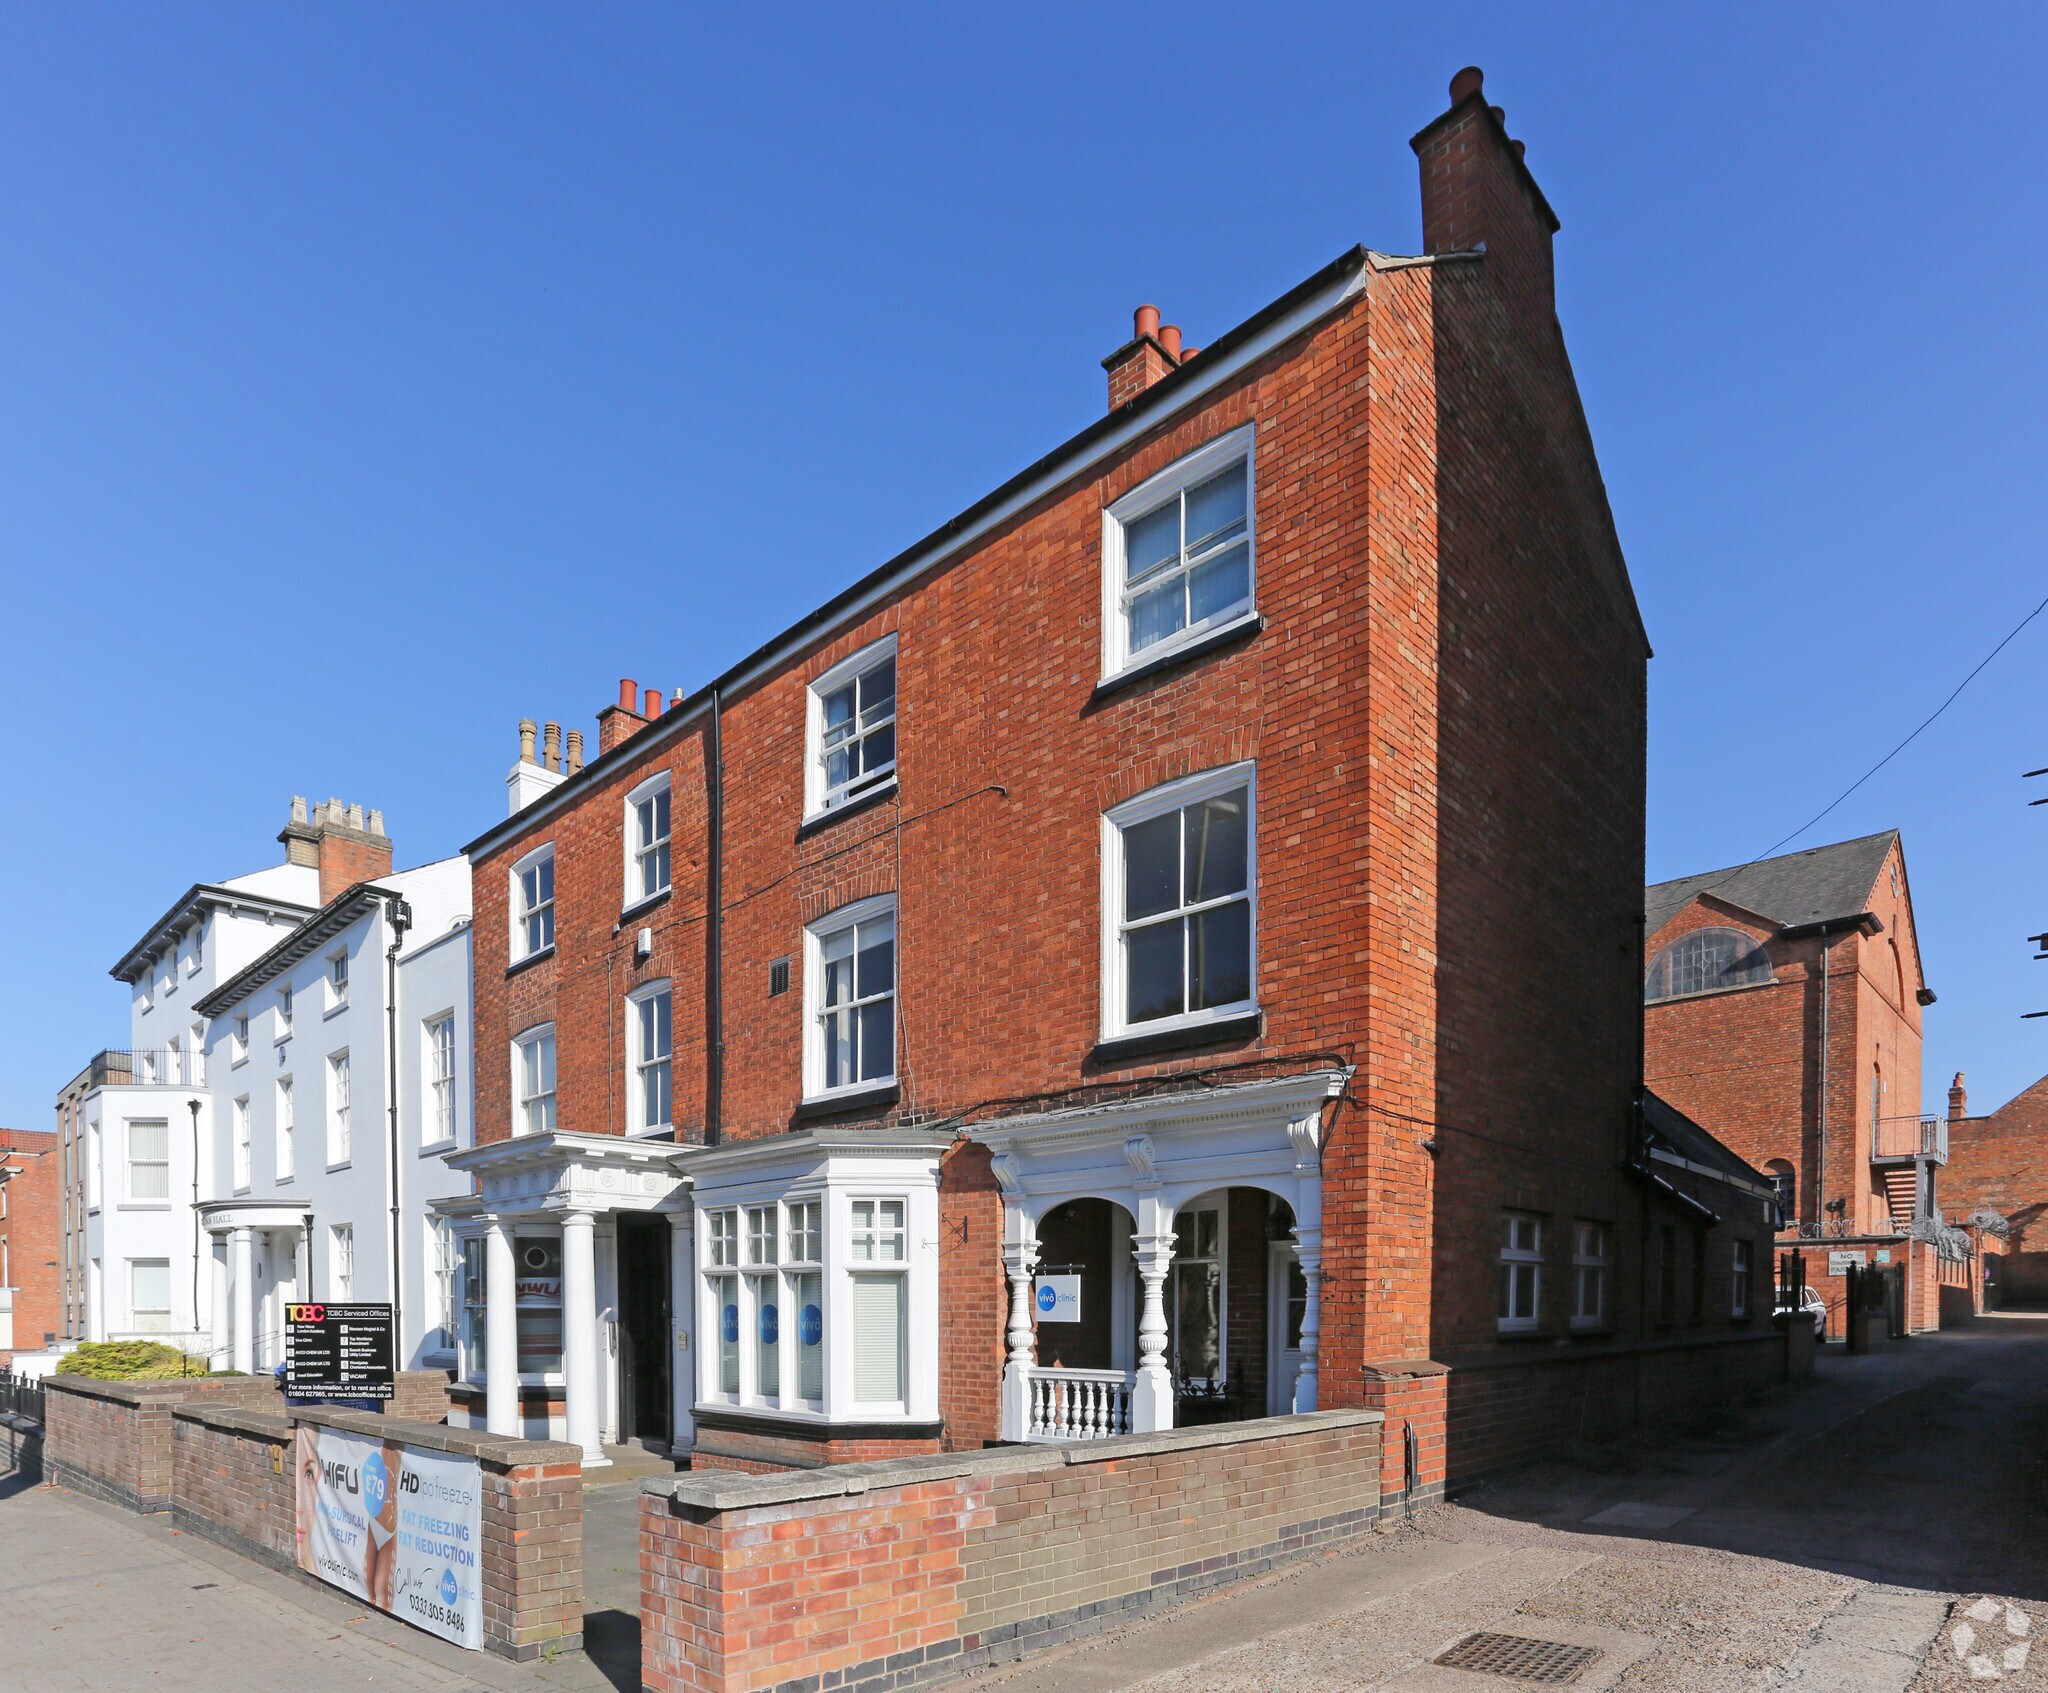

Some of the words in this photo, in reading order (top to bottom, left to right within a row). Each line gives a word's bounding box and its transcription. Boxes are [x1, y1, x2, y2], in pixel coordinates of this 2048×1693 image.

[213, 1214, 233, 1224] HALL
[1057, 1294, 1076, 1302] clinic
[321, 1459, 359, 1495] HIFU
[366, 1474, 384, 1500] £79
[400, 1470, 419, 1494] HD
[318, 1501, 366, 1531] NN-SURGICAL
[402, 1509, 416, 1526] FAT
[419, 1515, 469, 1541] FREEZING
[398, 1530, 412, 1548] FAT
[416, 1536, 474, 1567] REDUCTION
[459, 1584, 475, 1600] clinic
[409, 1594, 427, 1615] 0333
[428, 1603, 444, 1622] 305
[446, 1609, 465, 1632] 8486
